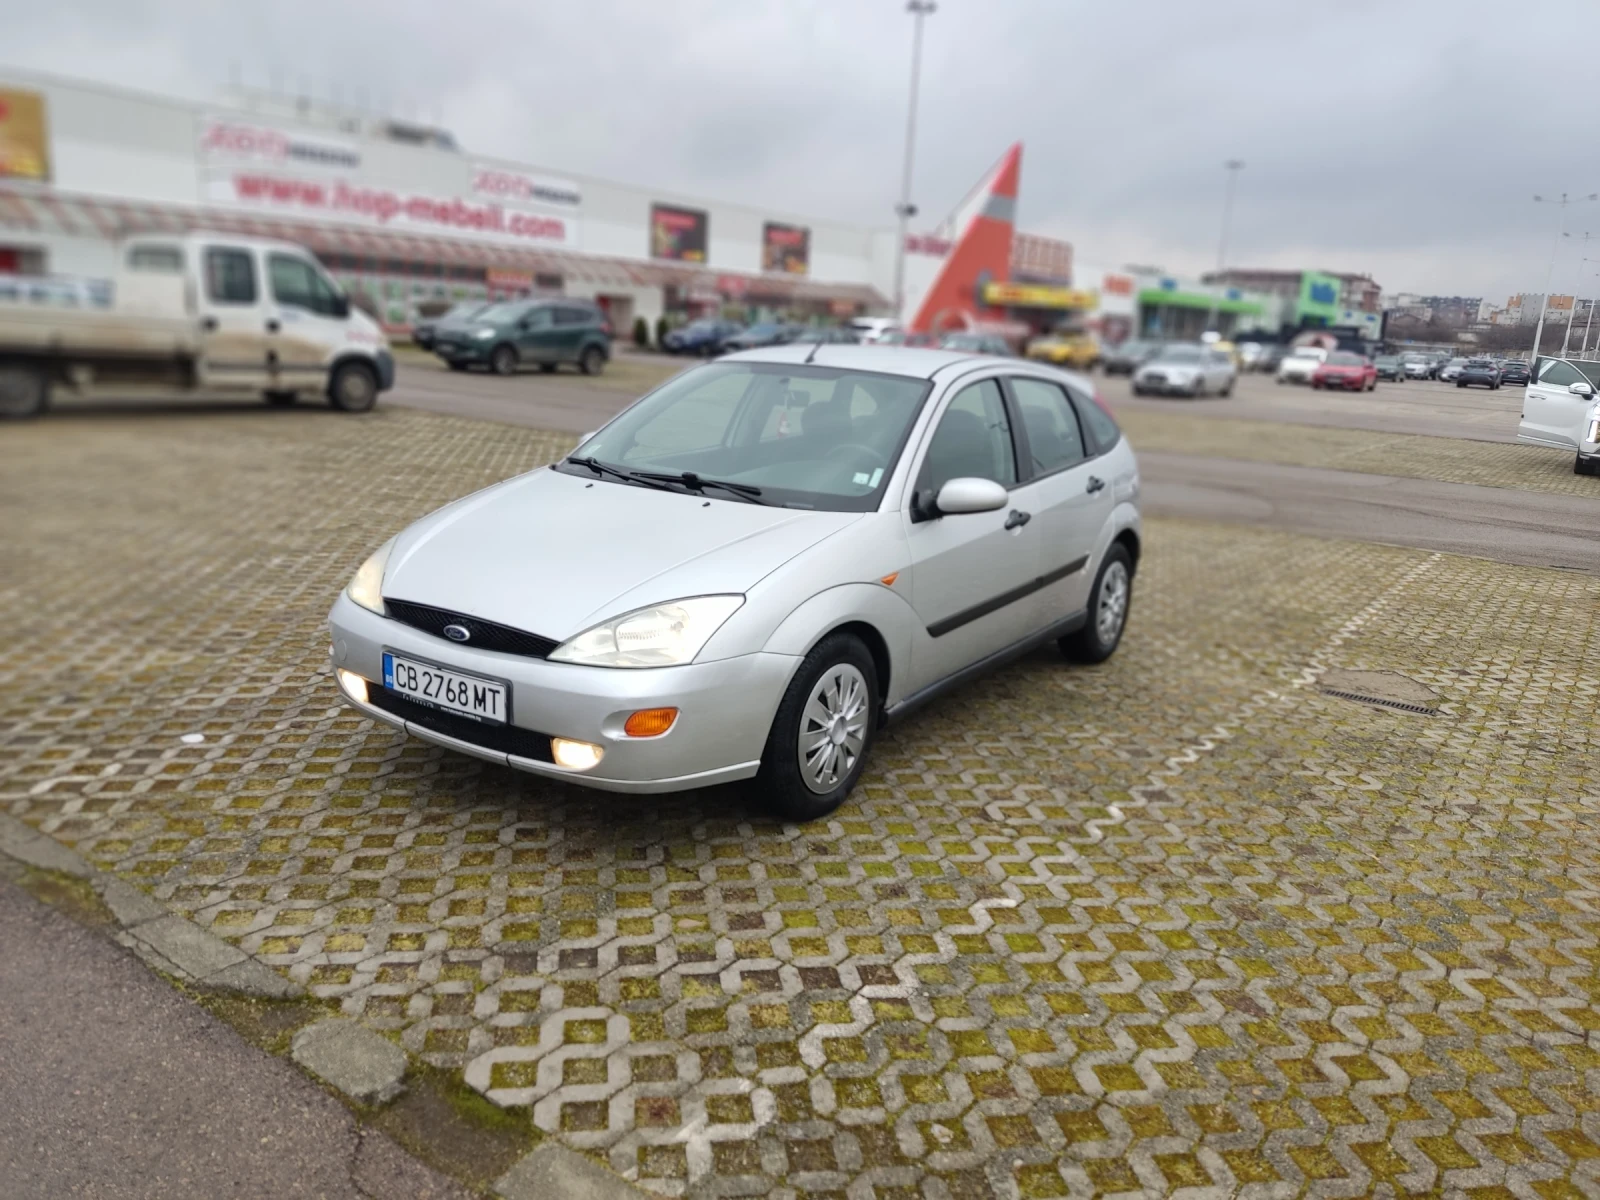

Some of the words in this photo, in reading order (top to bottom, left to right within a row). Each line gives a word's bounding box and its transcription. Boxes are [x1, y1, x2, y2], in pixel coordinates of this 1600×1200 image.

[395, 663, 419, 692] CB
[422, 671, 469, 707] 2768
[473, 684, 501, 715] MT
